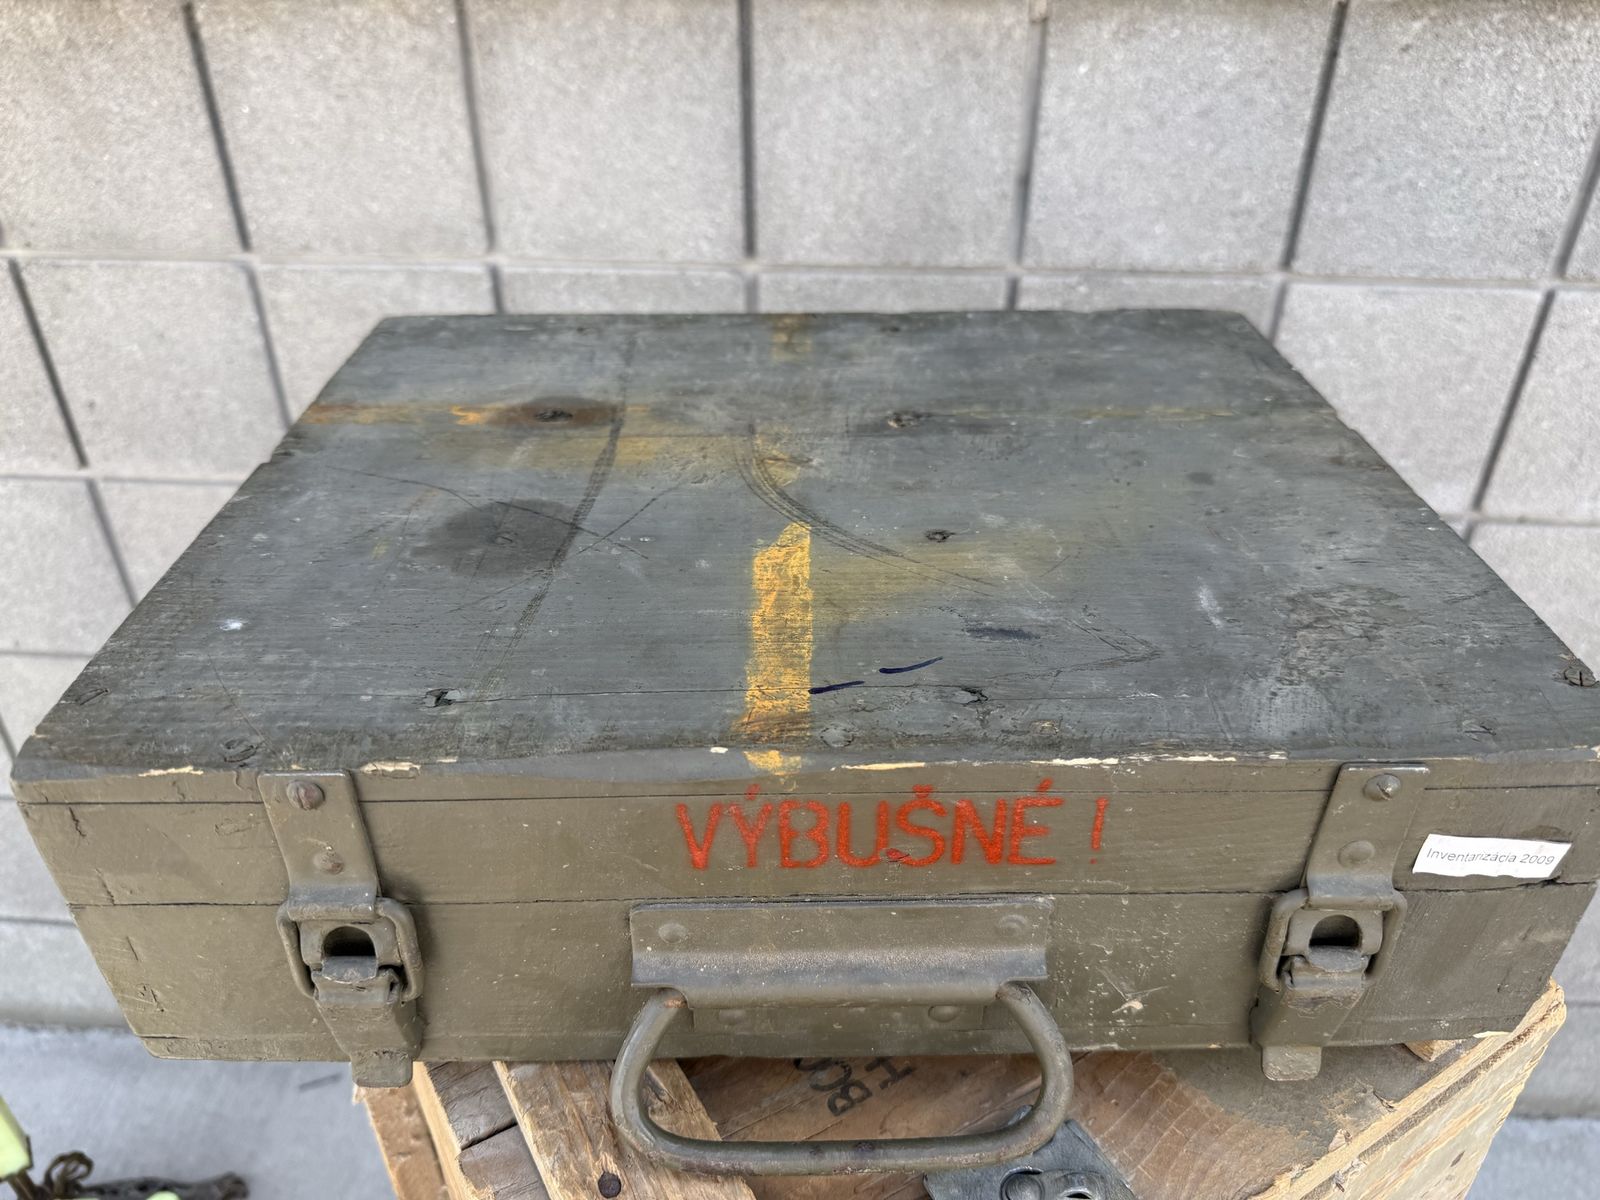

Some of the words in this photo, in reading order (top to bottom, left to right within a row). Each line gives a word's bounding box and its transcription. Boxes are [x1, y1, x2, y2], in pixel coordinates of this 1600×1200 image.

[676, 779, 1065, 869] VÝBUŠNÉ
[1091, 797, 1109, 865] !
[1426, 847, 1517, 864] Inventarizácia
[1519, 853, 1555, 866] 2009
